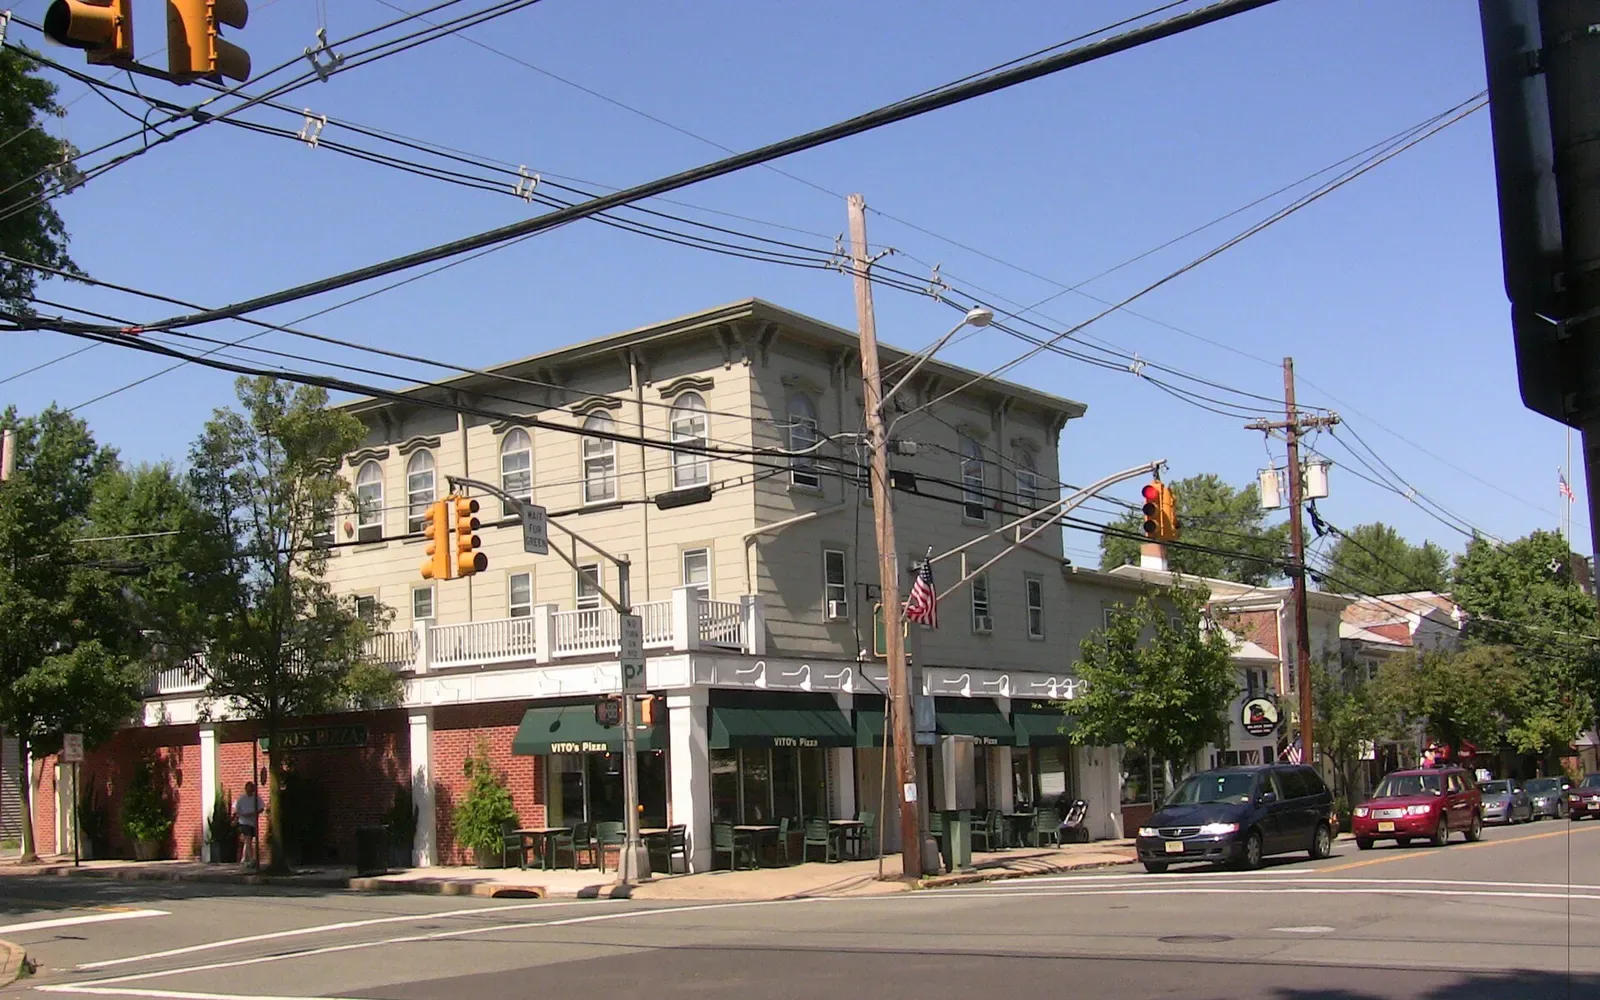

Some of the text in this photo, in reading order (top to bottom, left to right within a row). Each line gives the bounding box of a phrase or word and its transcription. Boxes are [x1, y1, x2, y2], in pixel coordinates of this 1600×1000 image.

[527, 511, 542, 521] WAIT
[529, 523, 541, 533] FOR
[526, 536, 546, 548] GREEN
[626, 619, 637, 628] NO
[624, 664, 636, 688] P
[551, 741, 607, 753] VITO's Pizza
[774, 737, 818, 747] VITO's Pizza
